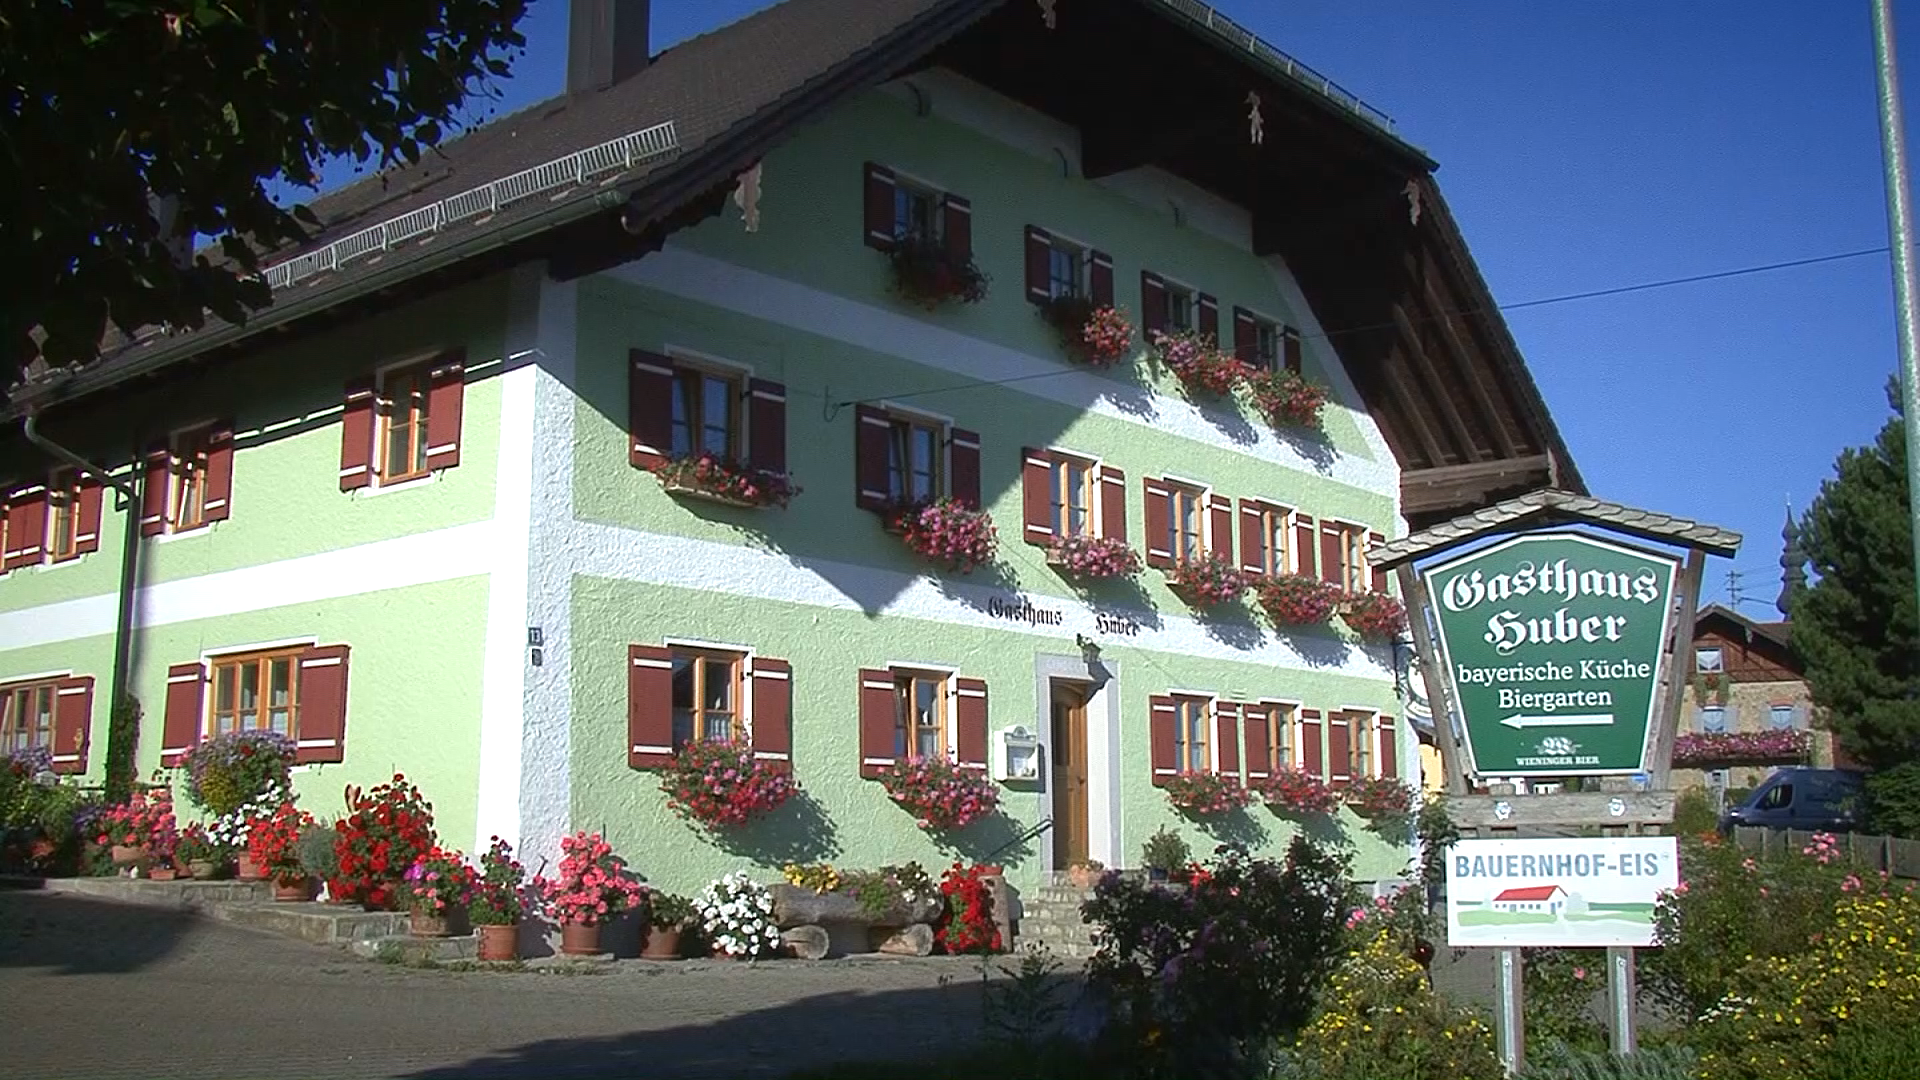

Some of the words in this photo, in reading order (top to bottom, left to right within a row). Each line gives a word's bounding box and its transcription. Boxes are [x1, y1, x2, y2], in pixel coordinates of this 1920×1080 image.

[1443, 559, 1658, 612] Gasthaus
[988, 593, 1063, 627] Gasthaus
[1096, 613, 1140, 637] Huber
[530, 629, 541, 642] 13
[1484, 608, 1627, 655] Huber
[1457, 662, 1574, 687] bayerische
[1579, 659, 1650, 680] Küche
[1499, 689, 1612, 710] Biergarten
[1516, 756, 1573, 766] WIENINGER
[1575, 756, 1600, 765] BIER
[1455, 852, 1659, 878] BAUERNHOF-EIS
